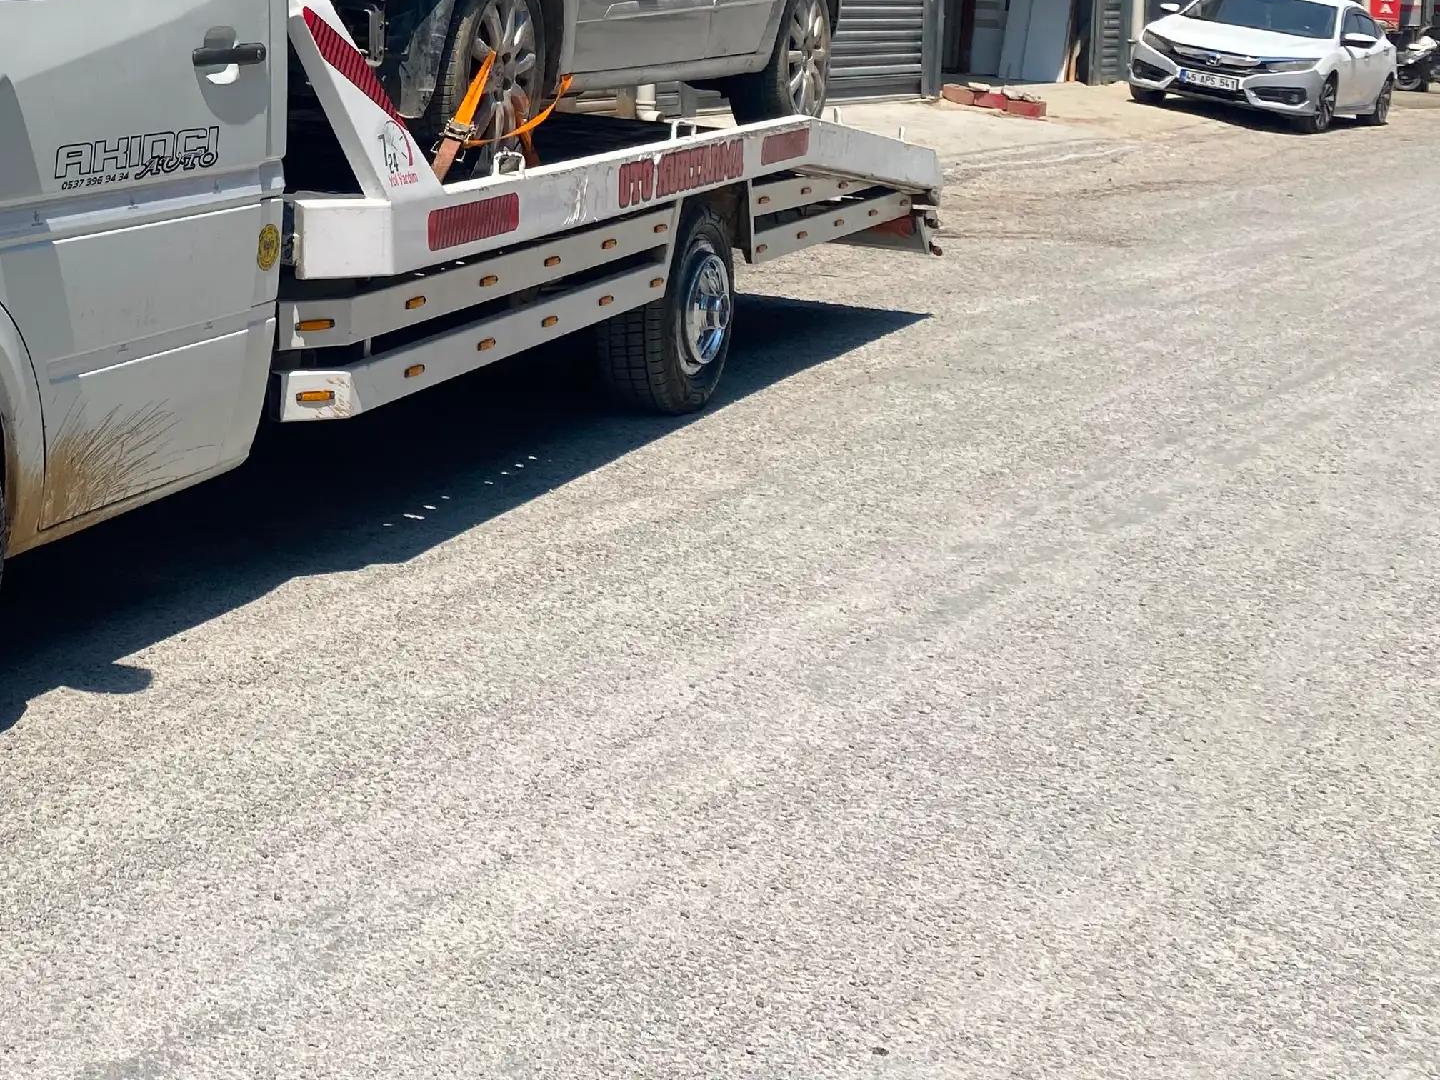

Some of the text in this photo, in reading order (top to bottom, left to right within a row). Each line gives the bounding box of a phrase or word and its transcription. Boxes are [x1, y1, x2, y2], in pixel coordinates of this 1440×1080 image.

[1200, 75, 1216, 86] APS
[1219, 78, 1235, 89] 541
[134, 149, 219, 180] AUTO
[617, 138, 745, 209] OTO KURTARMA
[61, 178, 85, 191] 0537
